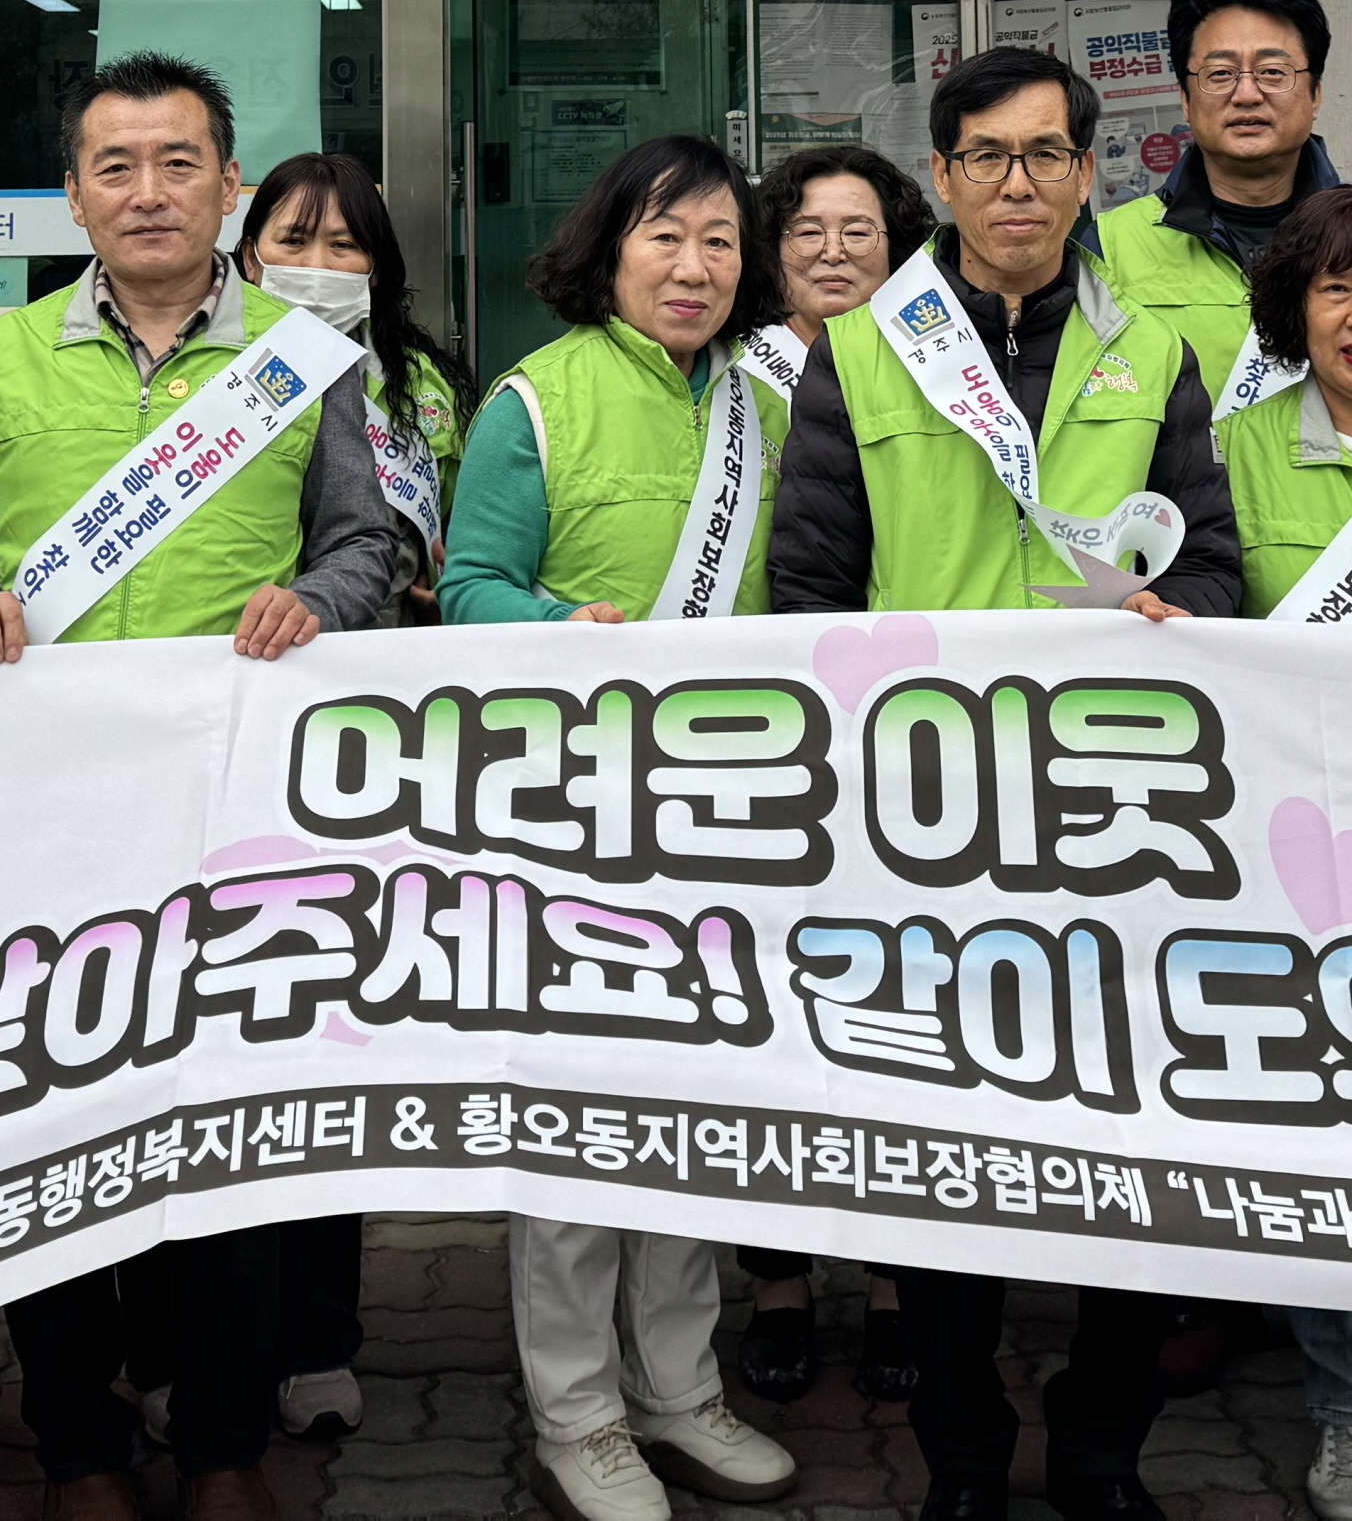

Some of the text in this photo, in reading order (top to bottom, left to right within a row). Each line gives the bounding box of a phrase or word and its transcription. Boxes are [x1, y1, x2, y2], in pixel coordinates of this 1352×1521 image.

[1090, 54, 1162, 81] 부정수급
[71, 489, 126, 548] 함께
[90, 426, 246, 576] 도움이 필요한
[121, 420, 204, 498] 이웃을
[293, 678, 1236, 894] 어려운 이웃
[791, 917, 1136, 1107] 같이
[389, 1095, 439, 1152] &
[456, 1092, 1151, 1227] 황오동지역사회보장협의체
